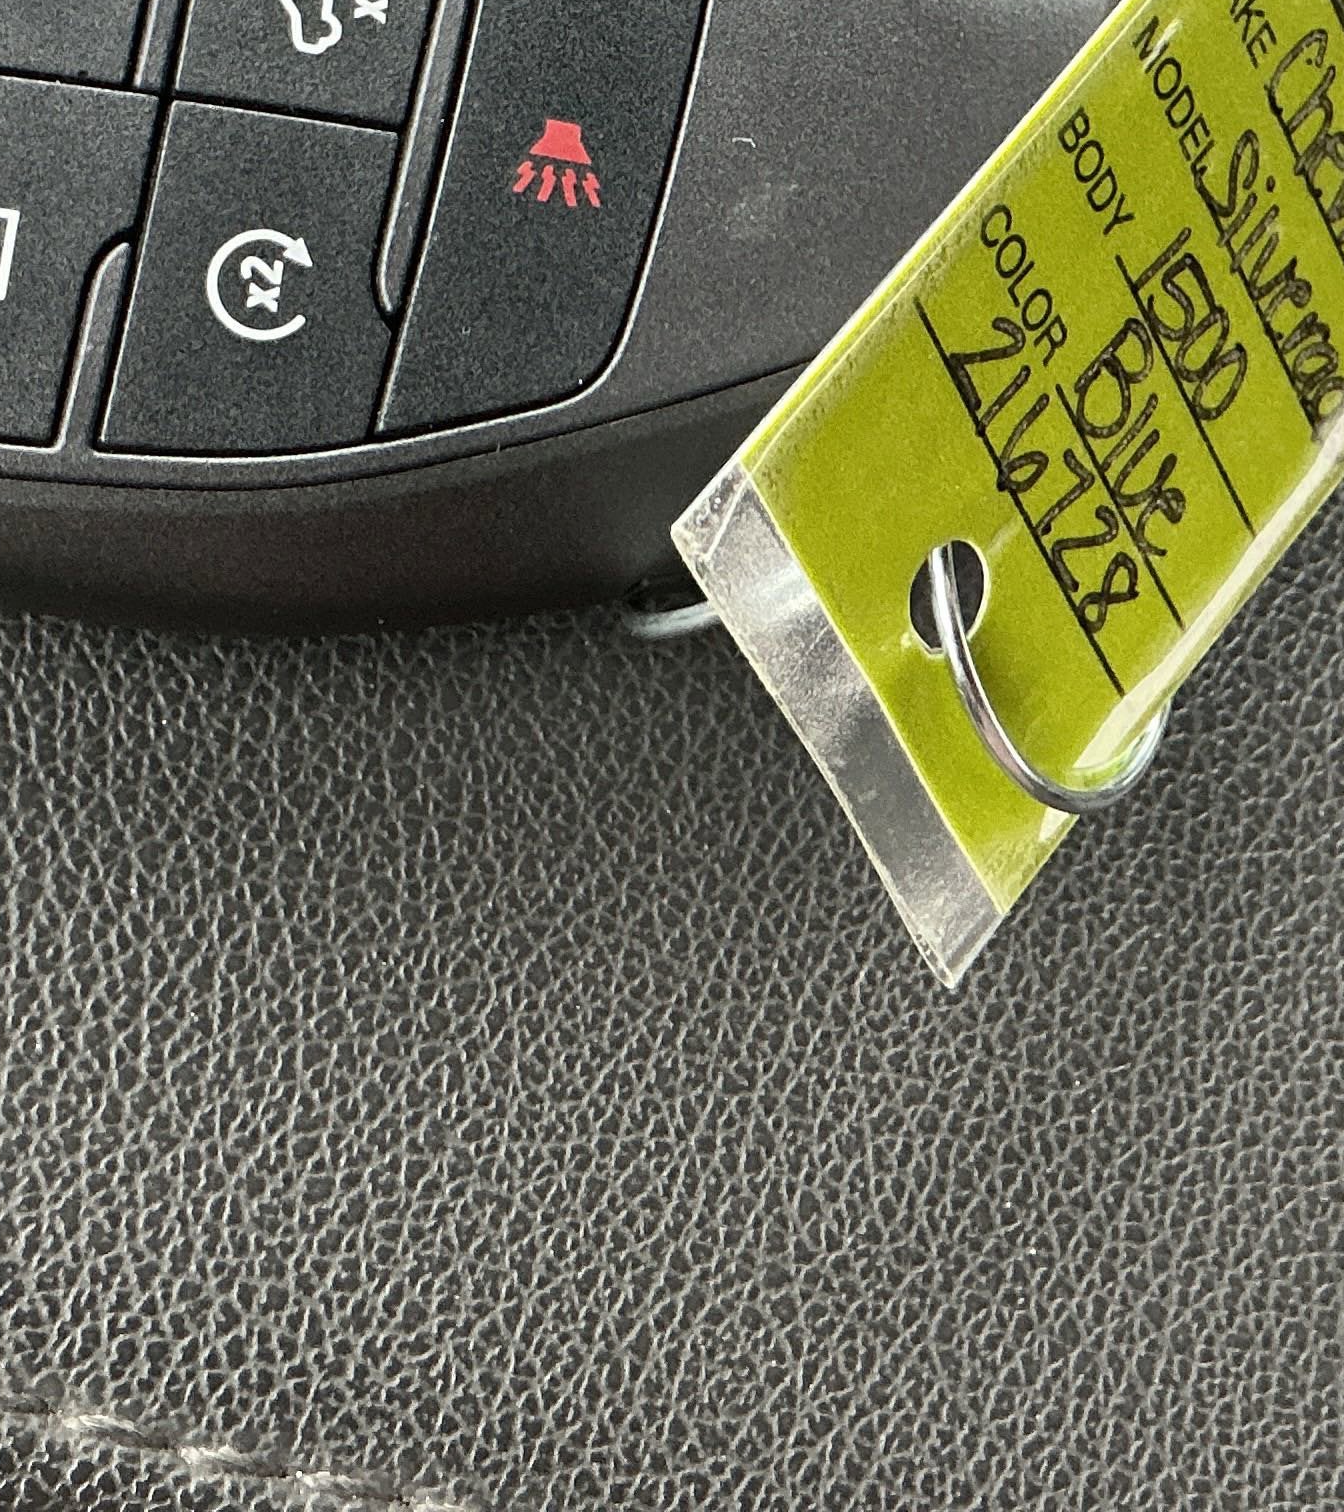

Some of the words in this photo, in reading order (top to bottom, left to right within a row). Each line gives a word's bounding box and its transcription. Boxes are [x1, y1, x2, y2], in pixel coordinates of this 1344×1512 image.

[1132, 16, 1216, 180] MODEL
[979, 203, 1068, 367] COLOR
[1075, 317, 1187, 557] Blue
[1057, 106, 1136, 237] BODY
[1132, 227, 1248, 421] 1500
[949, 316, 1139, 634] 216728
